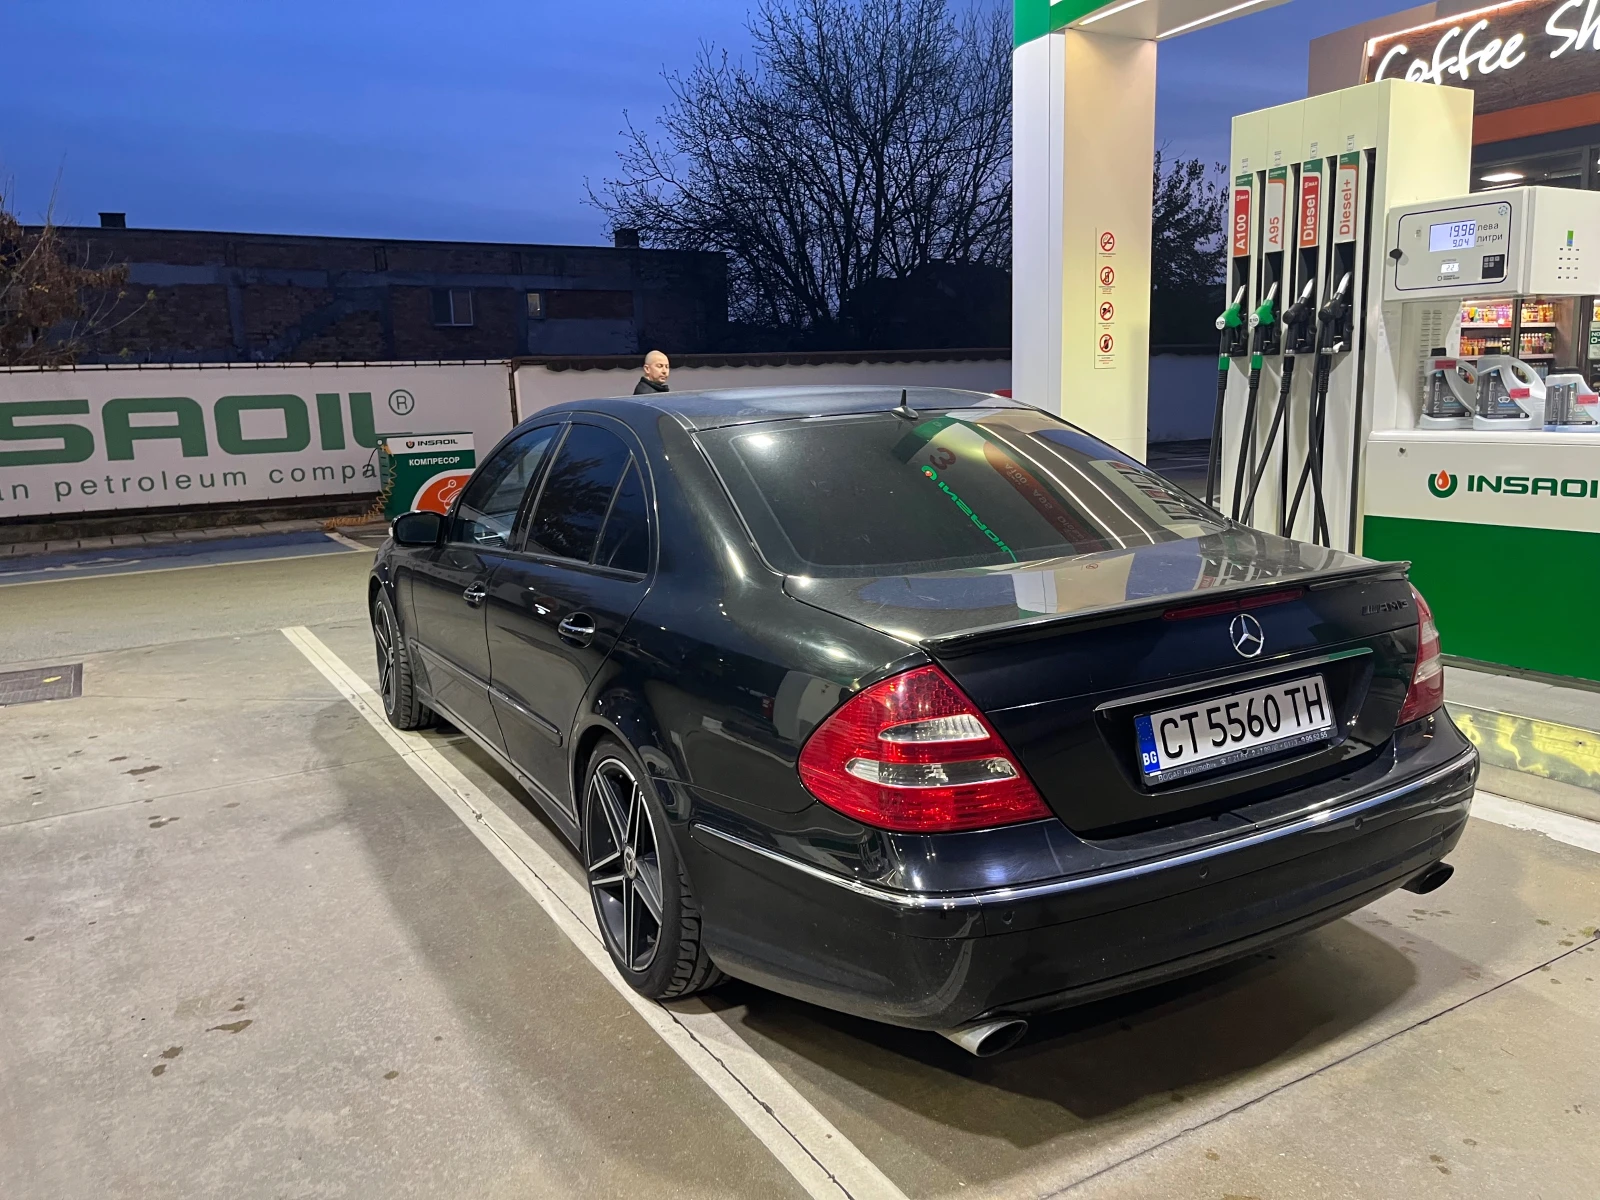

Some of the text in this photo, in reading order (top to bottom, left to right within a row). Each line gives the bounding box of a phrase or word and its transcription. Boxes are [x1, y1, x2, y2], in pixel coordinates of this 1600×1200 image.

[1375, 19, 1526, 85] Coffee
[1303, 194, 1316, 241] Diesel
[1339, 179, 1352, 235] Diesel+
[1236, 214, 1247, 249] A100
[1269, 217, 1280, 244] A95
[1476, 233, 1503, 243] литри
[1477, 223, 1499, 231] лева
[409, 456, 460, 466] КОМПРЕСОР
[54, 470, 247, 501] petroleum
[1206, 693, 1281, 748] 5560
[1142, 751, 1158, 766] BG
